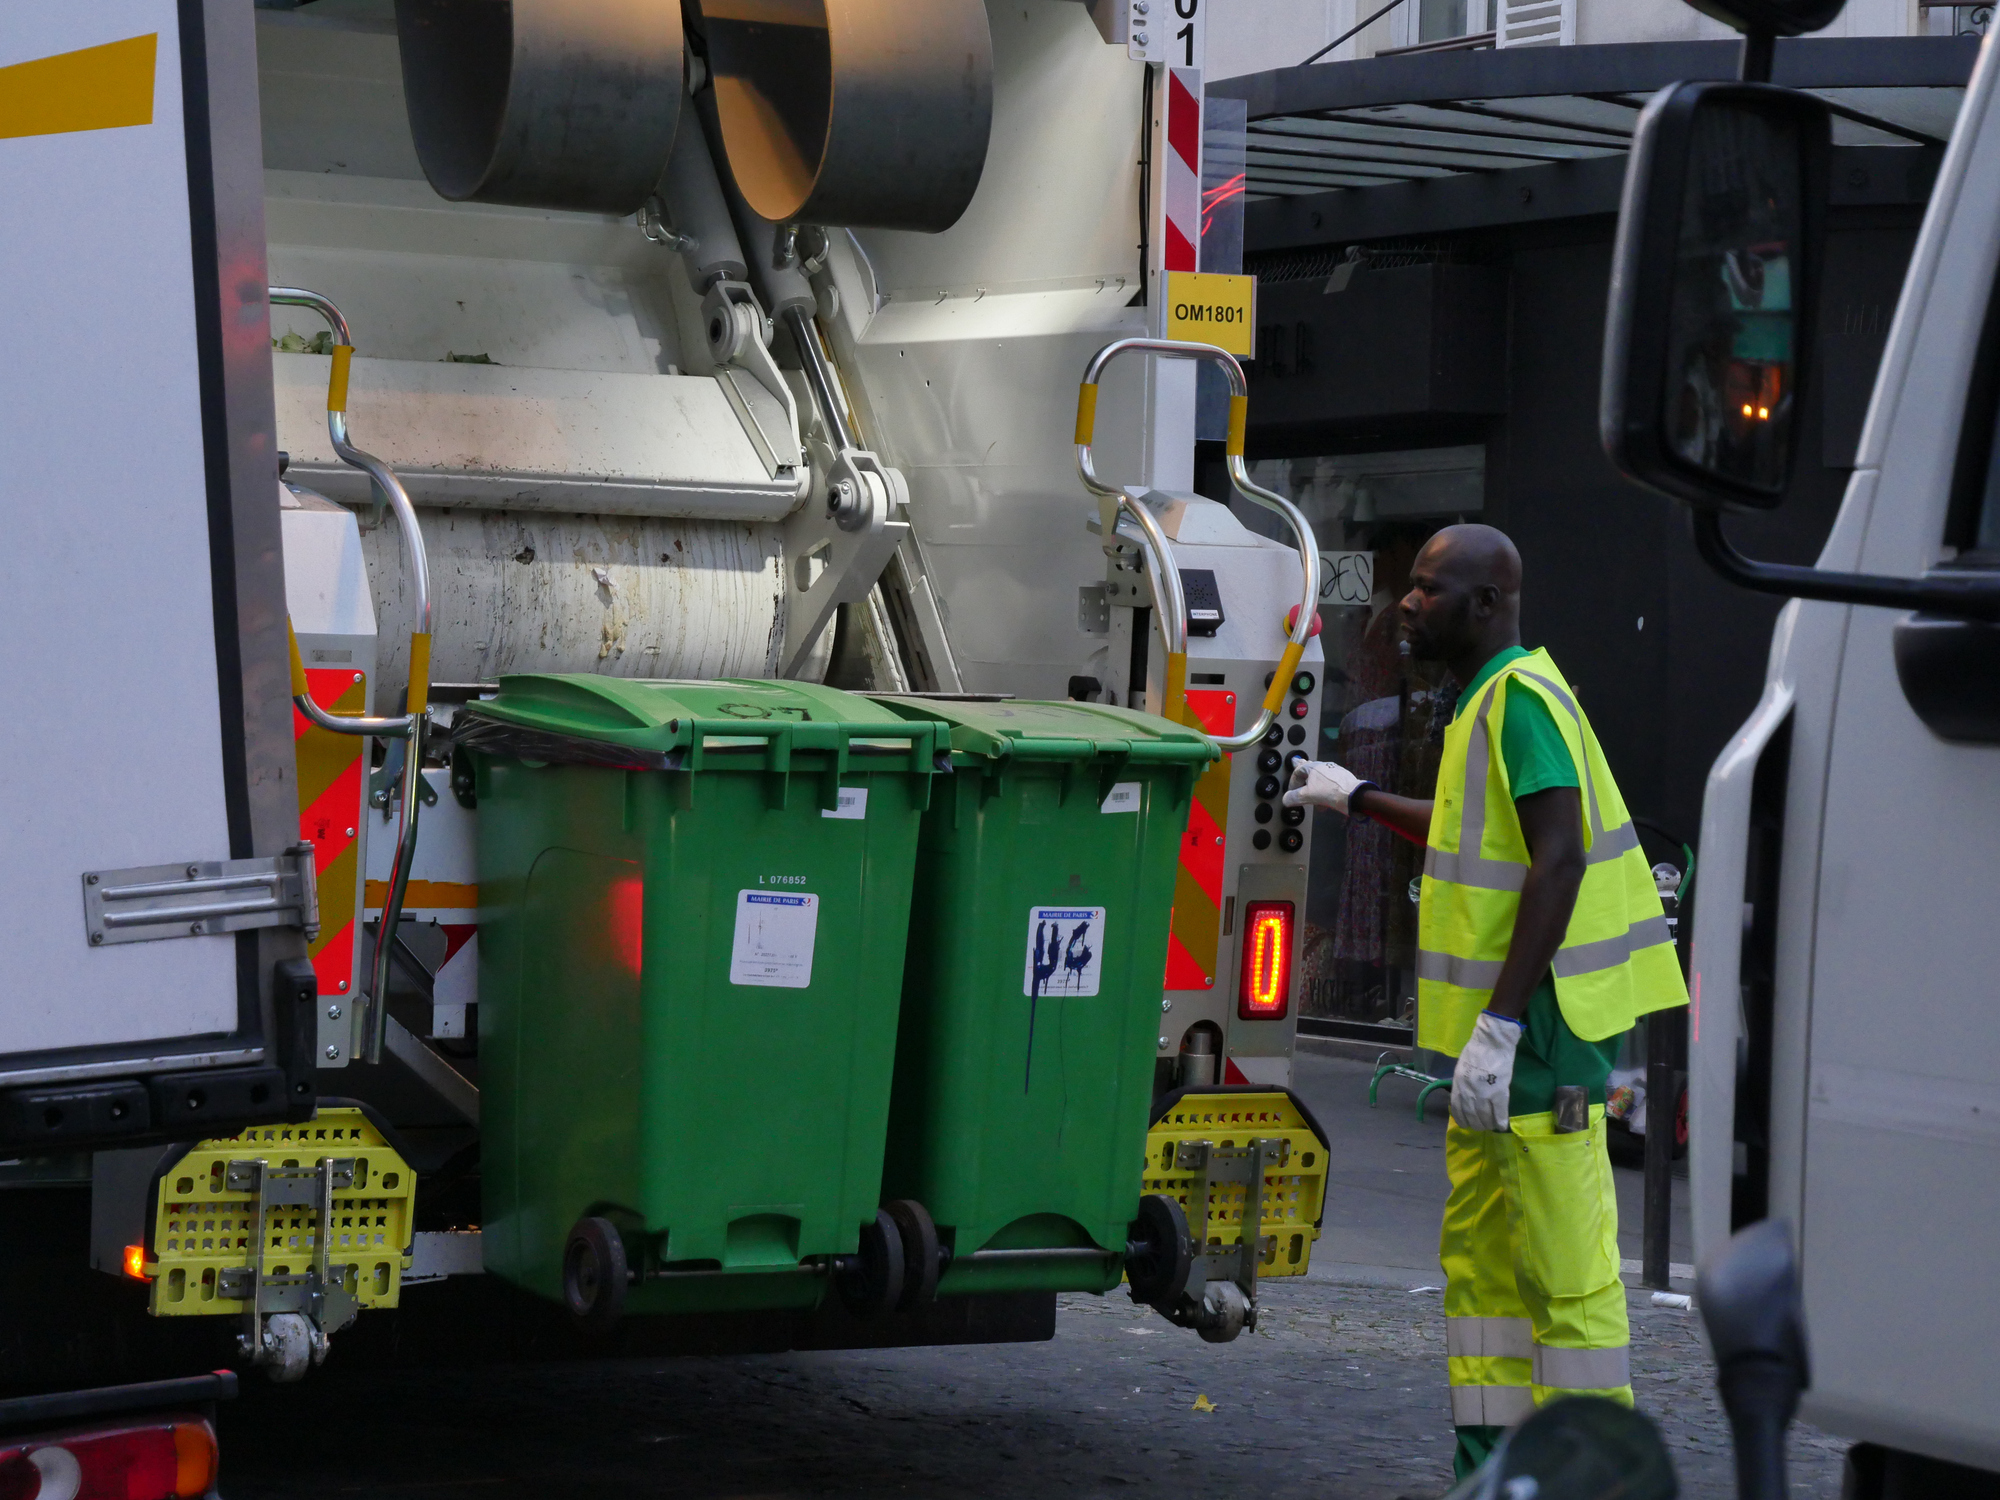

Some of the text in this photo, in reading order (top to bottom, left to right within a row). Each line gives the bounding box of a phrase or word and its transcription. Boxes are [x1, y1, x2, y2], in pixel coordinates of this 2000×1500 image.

[1175, 303, 1243, 323] OM1801
[759, 875, 807, 885] L 076852
